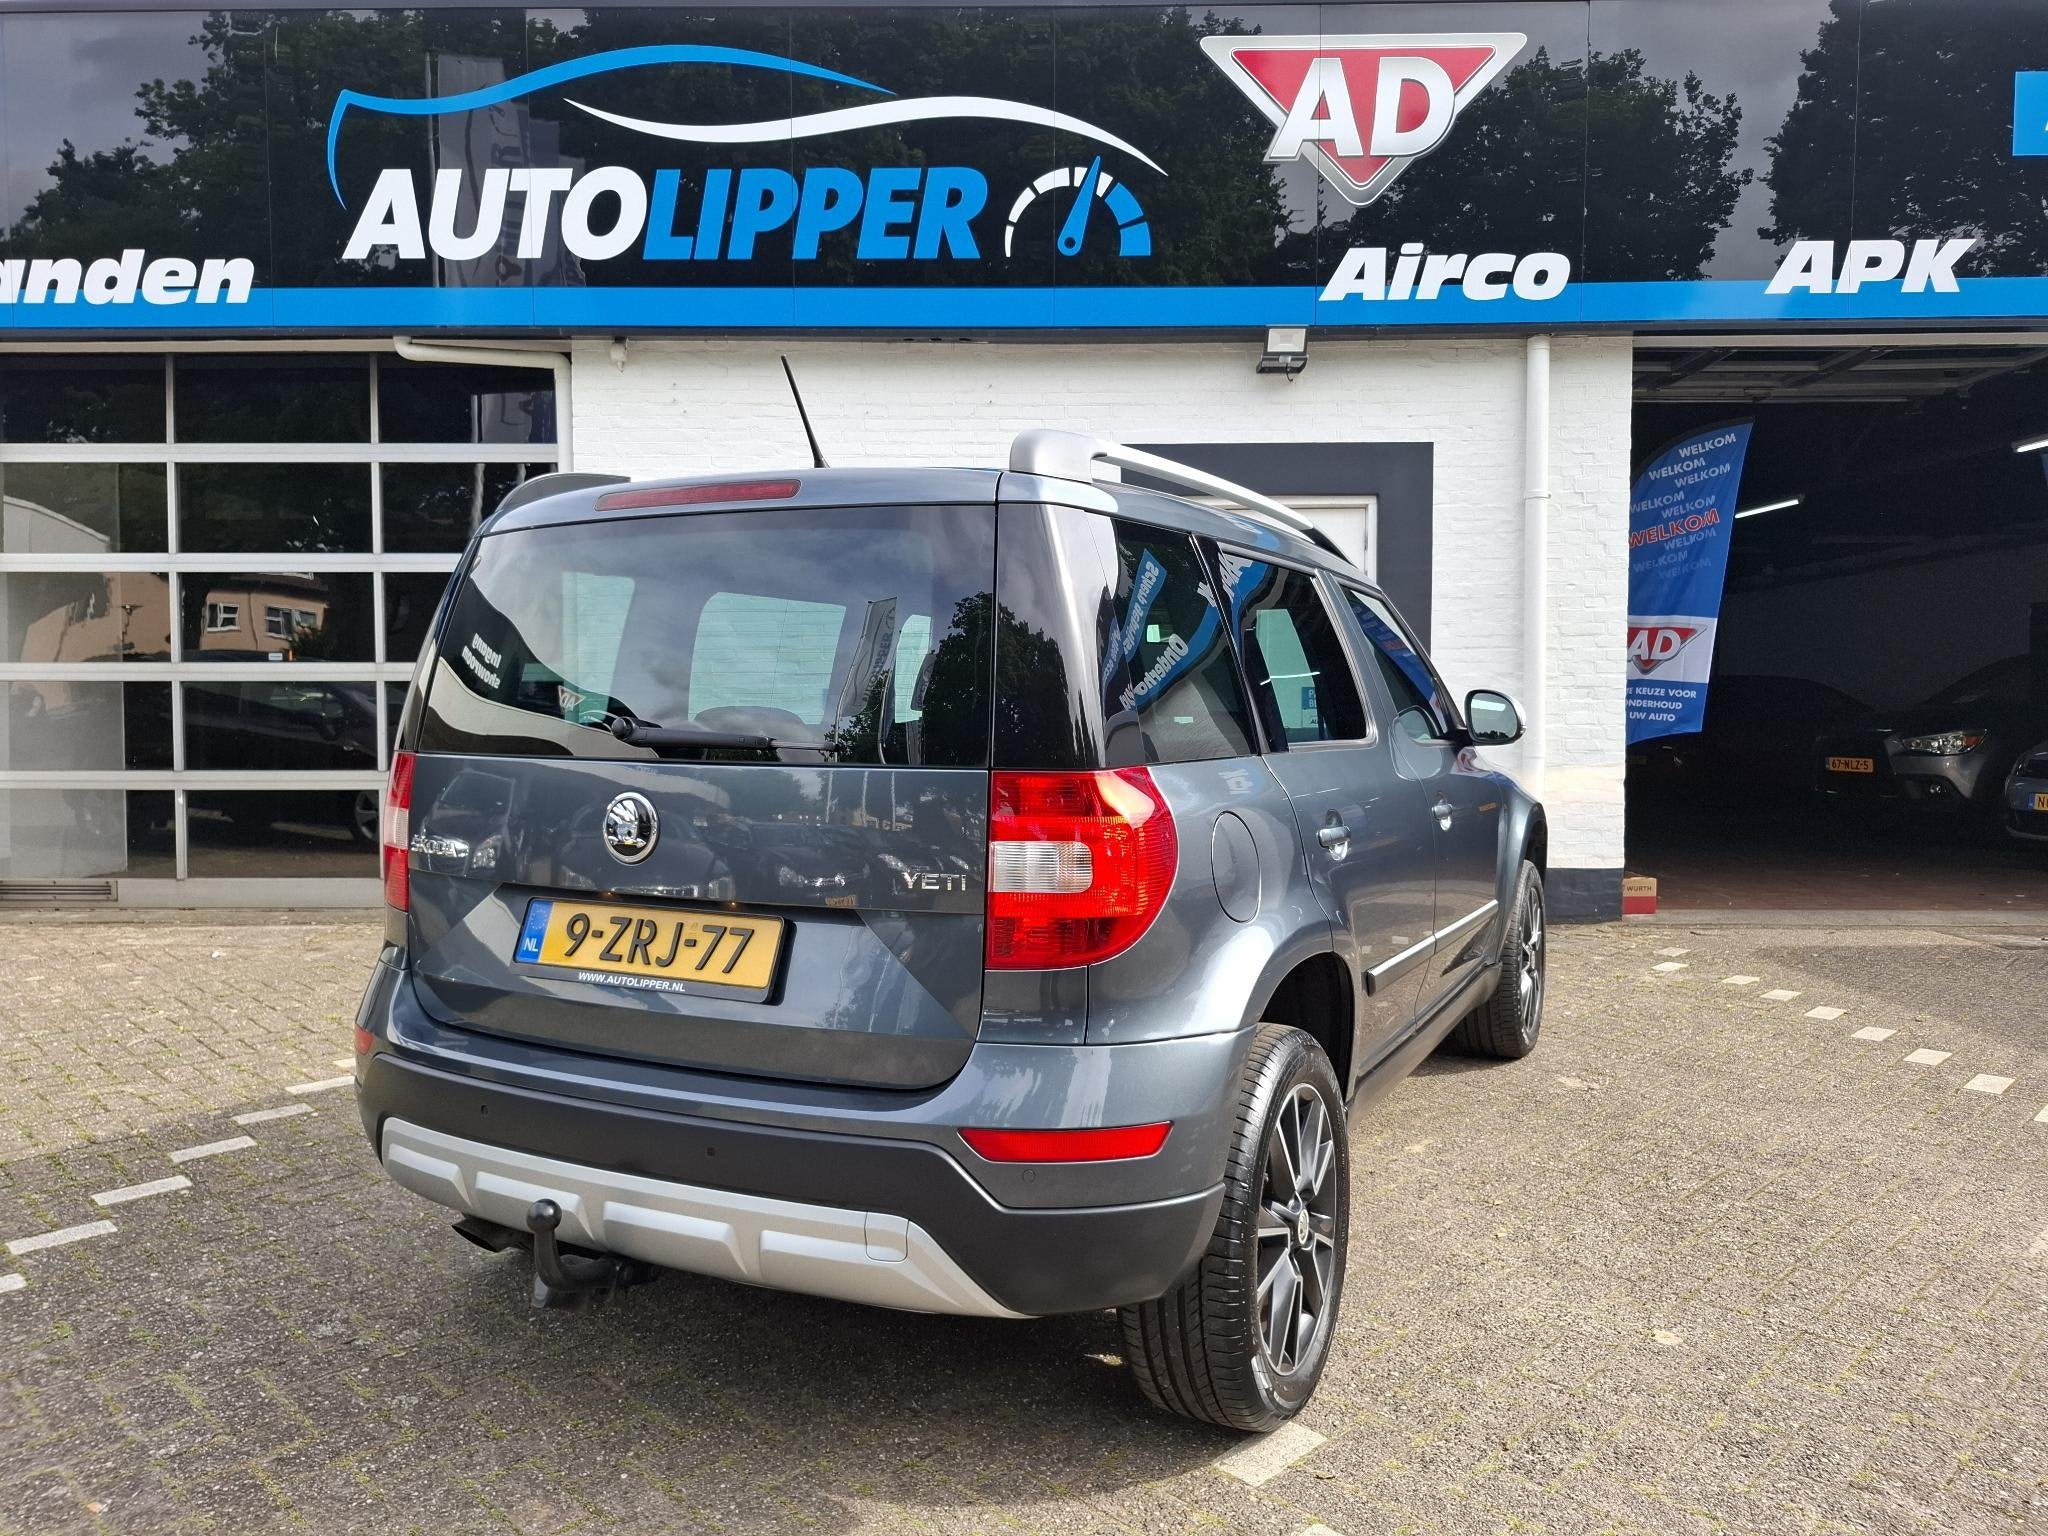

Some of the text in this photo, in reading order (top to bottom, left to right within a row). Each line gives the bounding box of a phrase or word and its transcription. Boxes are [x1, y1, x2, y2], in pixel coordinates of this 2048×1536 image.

[1266, 56, 1456, 159] AD
[341, 165, 989, 260] AUTOLIPPER
[1319, 243, 1571, 301] Airco
[1764, 239, 1977, 294] APK
[1679, 433, 1737, 458] WELKOM
[1648, 457, 1706, 480] WELKOM
[1674, 463, 1731, 488] WELKOM
[1630, 491, 1685, 514] WELKOM
[1661, 495, 1716, 519] WELKOM
[1629, 508, 1720, 549] WELKOM
[1664, 527, 1717, 550] WELKOM
[1633, 550, 1688, 573] WELKOM
[1628, 629, 1681, 661] AD
[1635, 687, 1665, 697] KEUZE
[1668, 688, 1697, 699] VOOR
[1629, 711, 1676, 722] UW AUTO
[901, 872, 967, 891] YETI
[523, 937, 539, 953] NL
[563, 911, 755, 974] 9-ZRJ-77
[577, 970, 686, 993] WWW.AUTOLIPPER.NL
